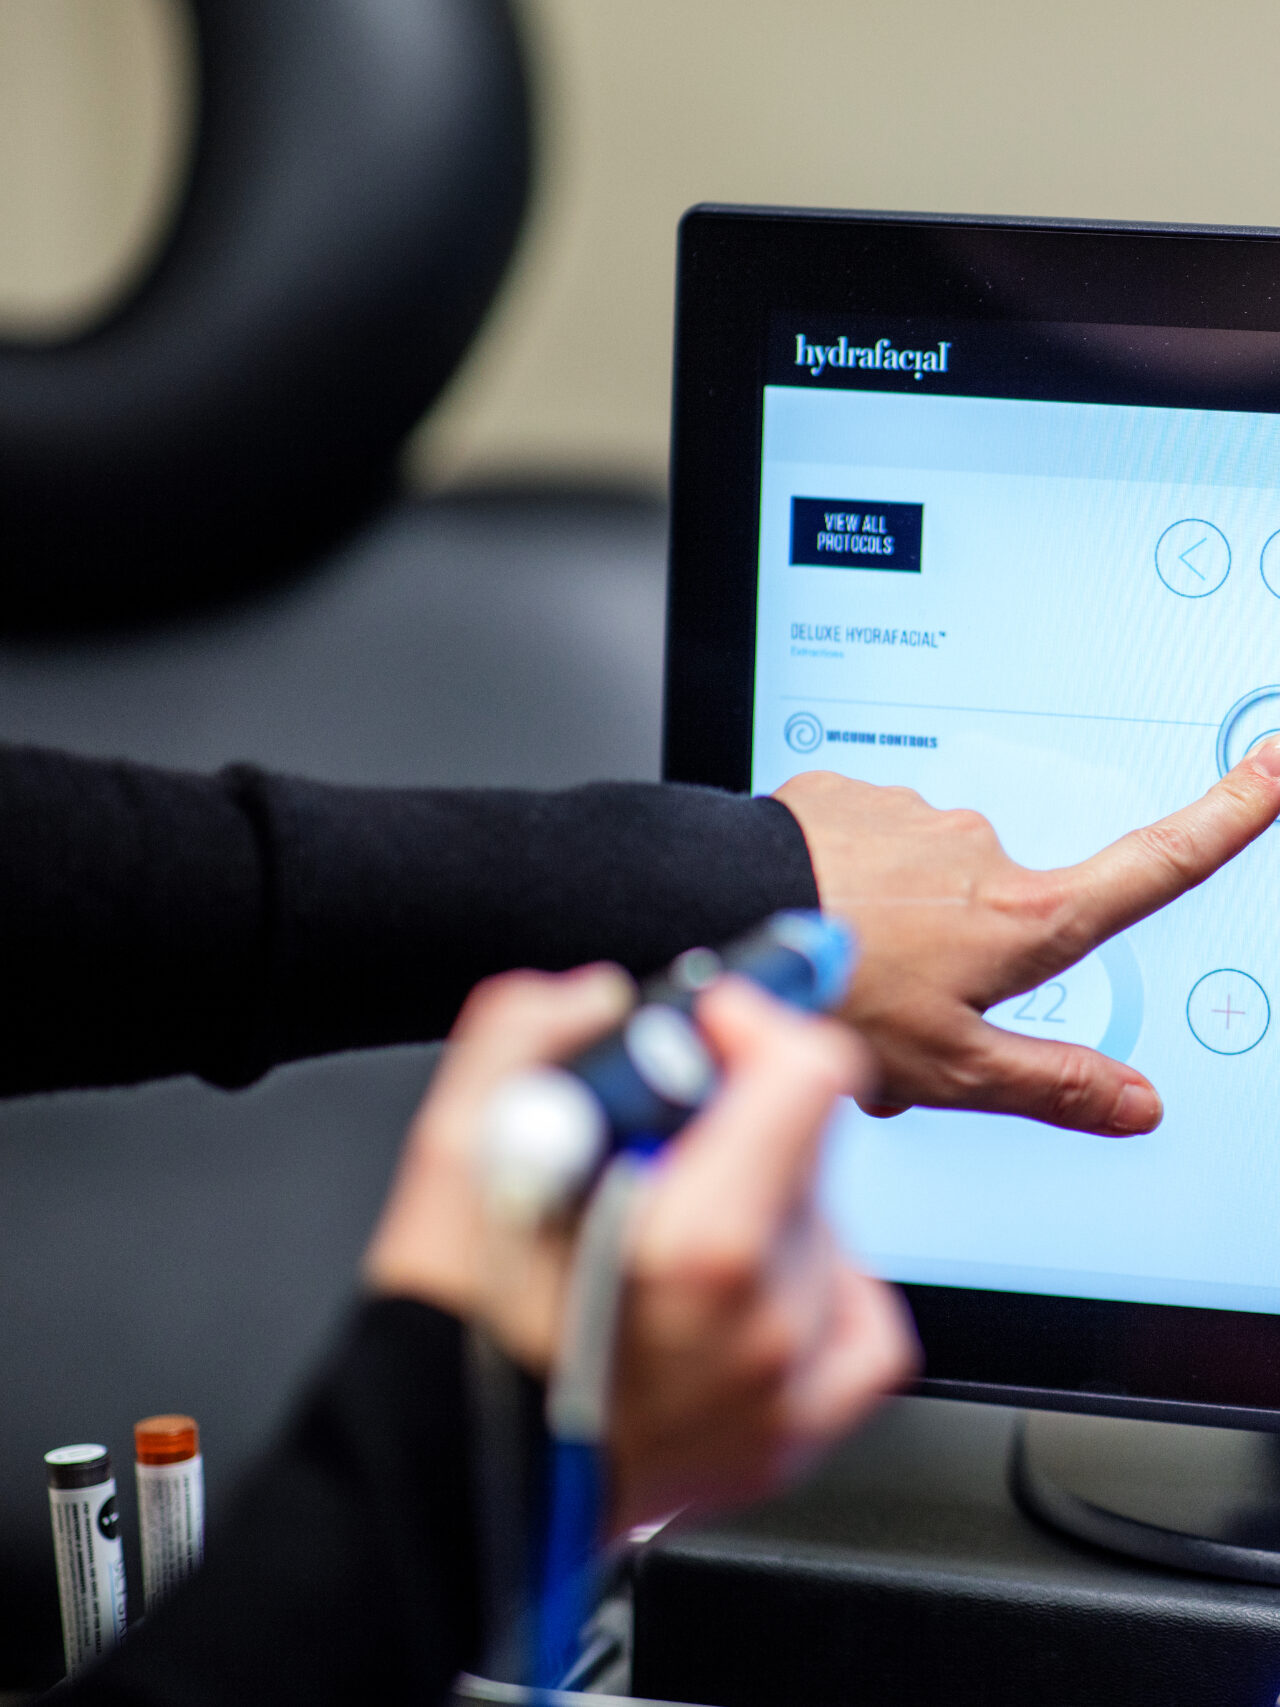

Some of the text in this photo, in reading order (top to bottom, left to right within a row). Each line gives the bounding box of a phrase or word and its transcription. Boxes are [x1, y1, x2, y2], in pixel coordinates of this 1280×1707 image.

[824, 512, 888, 535] VIEW ALL
[817, 531, 895, 556] PROTOCOLS
[790, 622, 841, 643] DELUXE
[879, 733, 938, 749] CONTROLS
[1013, 981, 1068, 1024] 22
